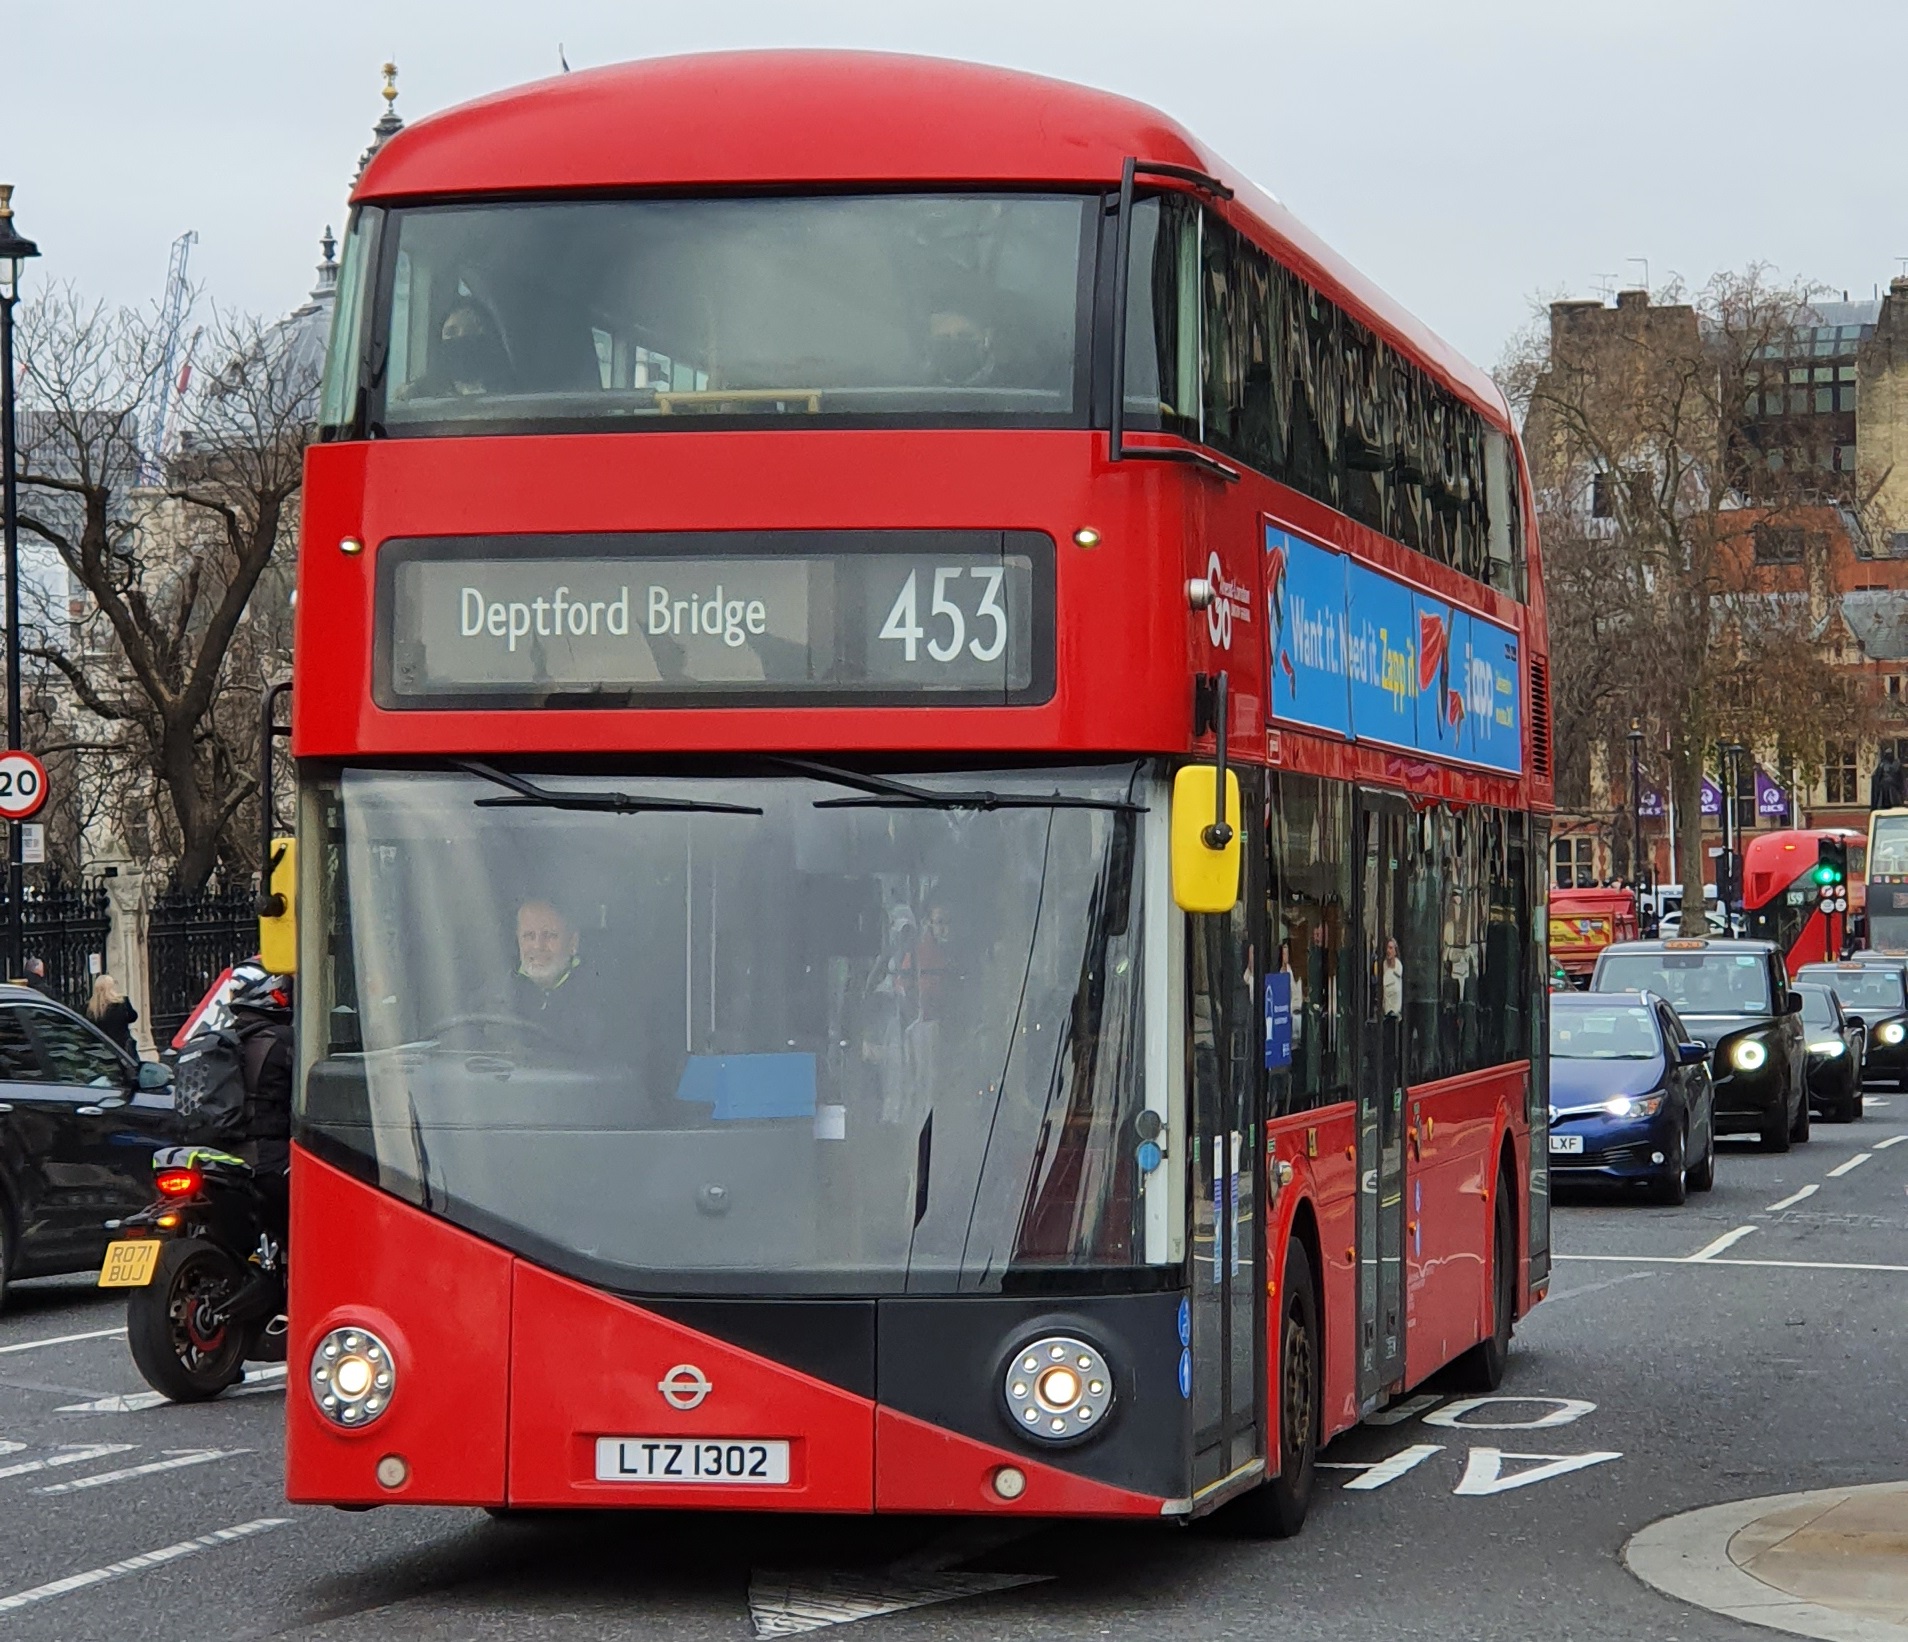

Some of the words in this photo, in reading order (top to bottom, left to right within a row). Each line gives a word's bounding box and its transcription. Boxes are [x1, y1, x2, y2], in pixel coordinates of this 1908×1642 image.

[460, 586, 630, 652] Deptford
[648, 585, 766, 648] Bridge
[878, 566, 1008, 663] 453
[1290, 594, 1324, 670] Want
[1325, 605, 1338, 674] it.
[1339, 612, 1367, 684] Need
[1368, 621, 1380, 687] it.
[0, 769, 37, 796] 20
[1701, 804, 1718, 813] ICS
[1760, 804, 1784, 813] RICS
[1551, 1137, 1577, 1150] LXF
[111, 1245, 153, 1263] RO71
[108, 1264, 145, 1281] BUJ
